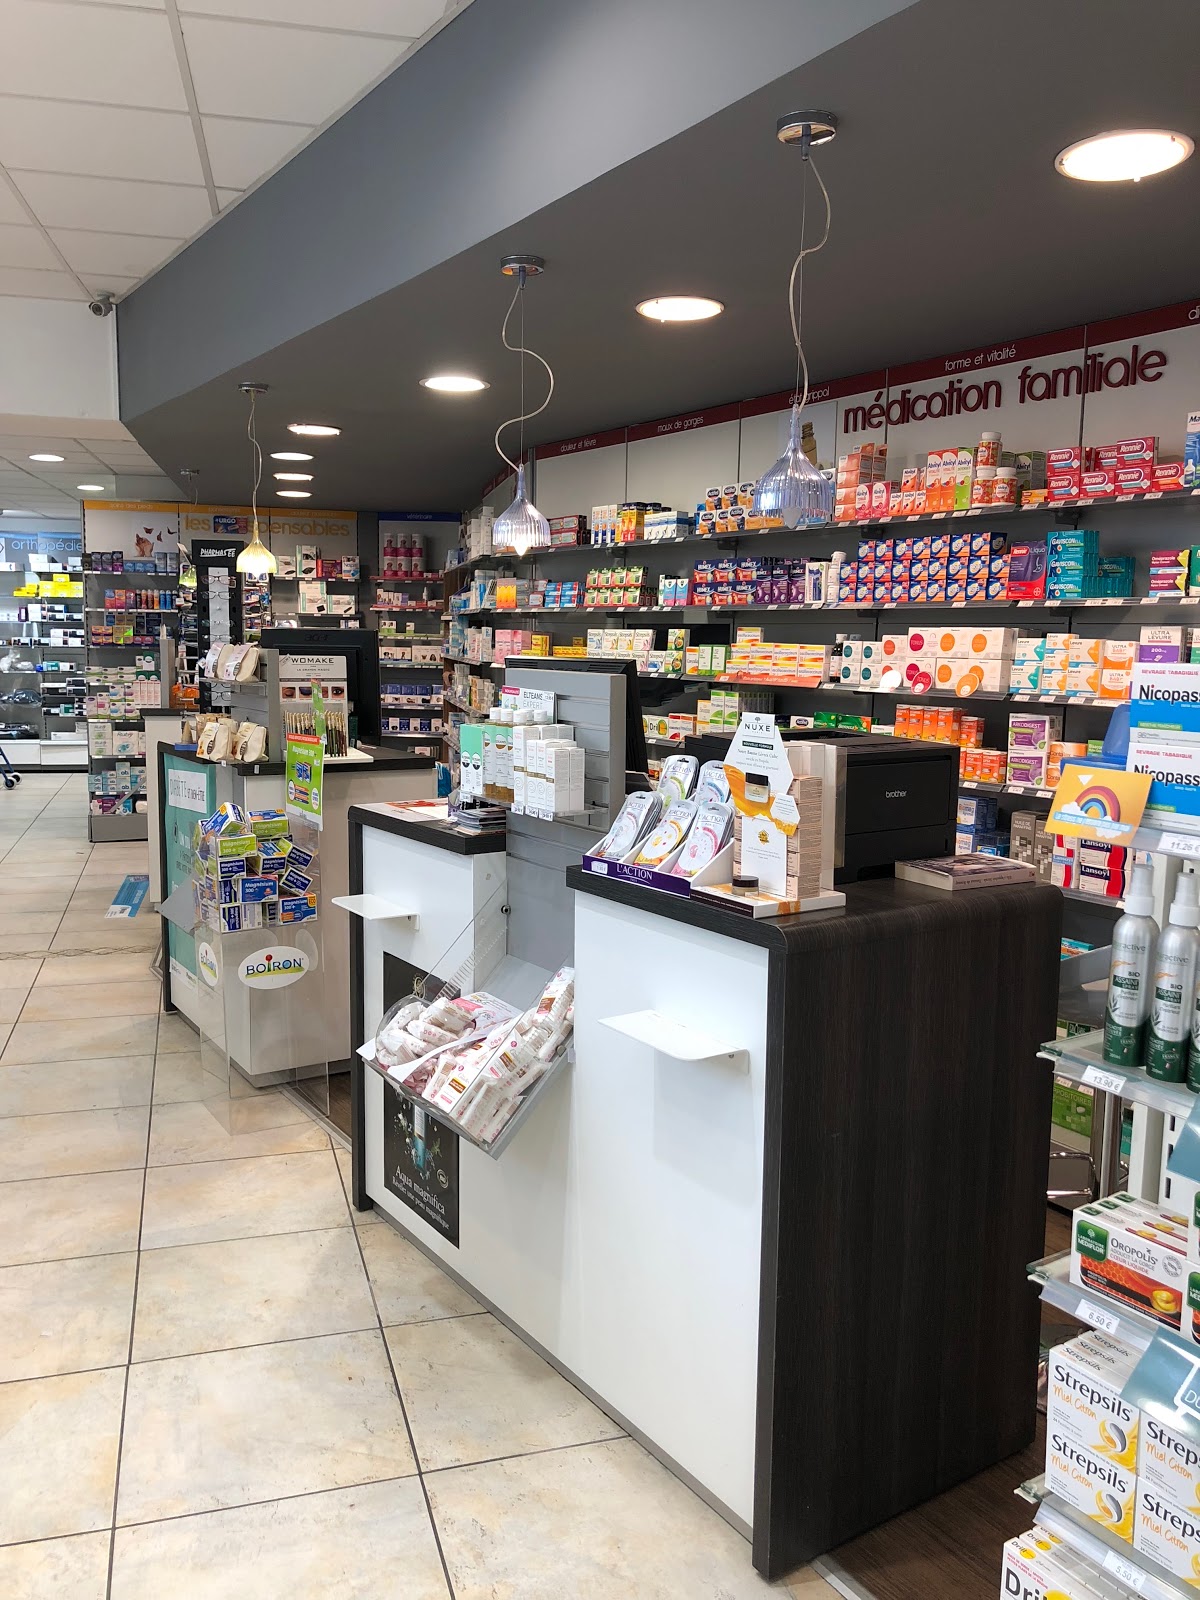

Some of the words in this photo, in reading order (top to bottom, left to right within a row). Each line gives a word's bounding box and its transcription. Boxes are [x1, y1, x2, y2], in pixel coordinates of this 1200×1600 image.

[944, 357, 971, 371] forme
[973, 353, 984, 365] et
[986, 344, 1017, 362] vitalité
[843, 380, 1001, 433] médication
[1018, 344, 1167, 404] familiale
[657, 421, 673, 432] maux
[674, 419, 682, 430] de
[683, 416, 704, 430] gorges
[560, 441, 578, 452] douleur
[583, 438, 597, 449] fièvre
[1120, 443, 1142, 453] Rennie
[1050, 452, 1070, 461] Rennie
[1099, 450, 1117, 459] Renni
[1083, 475, 1105, 485] Rennie
[1118, 471, 1140, 481] Rennie
[1154, 467, 1177, 477] Rennie
[1050, 479, 1069, 488] Rennie
[185, 515, 211, 531] les
[12, 539, 82, 553] orthopédie
[1013, 547, 1027, 555] Rennie
[744, 723, 771, 732] NUXE
[1134, 765, 1200, 786] Nicopass
[885, 790, 907, 798] brother
[222, 839, 251, 847] Magnésium
[1170, 842, 1193, 851] 11.26
[616, 863, 653, 880] L'ACTION
[1081, 866, 1110, 877] Lansoyl
[246, 954, 303, 976] BOIRON
[1093, 1075, 1114, 1088] 13.90
[395, 1165, 413, 1188] Aqua
[413, 1183, 445, 1215] magnifica
[1111, 1238, 1158, 1265] OROPOLIS
[1088, 1312, 1105, 1326] 6.50
[1105, 1321, 1112, 1330] €
[1079, 1340, 1116, 1365] Strepsils
[1092, 1333, 1131, 1358] Strepsils
[1063, 1346, 1102, 1372] Strepsils
[1054, 1364, 1132, 1422] Strepsils
[1053, 1384, 1073, 1406] Miel
[1074, 1397, 1097, 1421] Citron
[1051, 1433, 1127, 1494] Strepsils
[1146, 1441, 1166, 1462] Miel
[1168, 1457, 1193, 1481] Citron
[1050, 1453, 1070, 1475] Miel
[1071, 1468, 1094, 1491] Citron
[1141, 1513, 1163, 1537] Miel
[1164, 1529, 1190, 1554] Citron
[1011, 1541, 1028, 1553] Drill
[1115, 1565, 1131, 1581] 5.50
[1132, 1578, 1140, 1587] €
